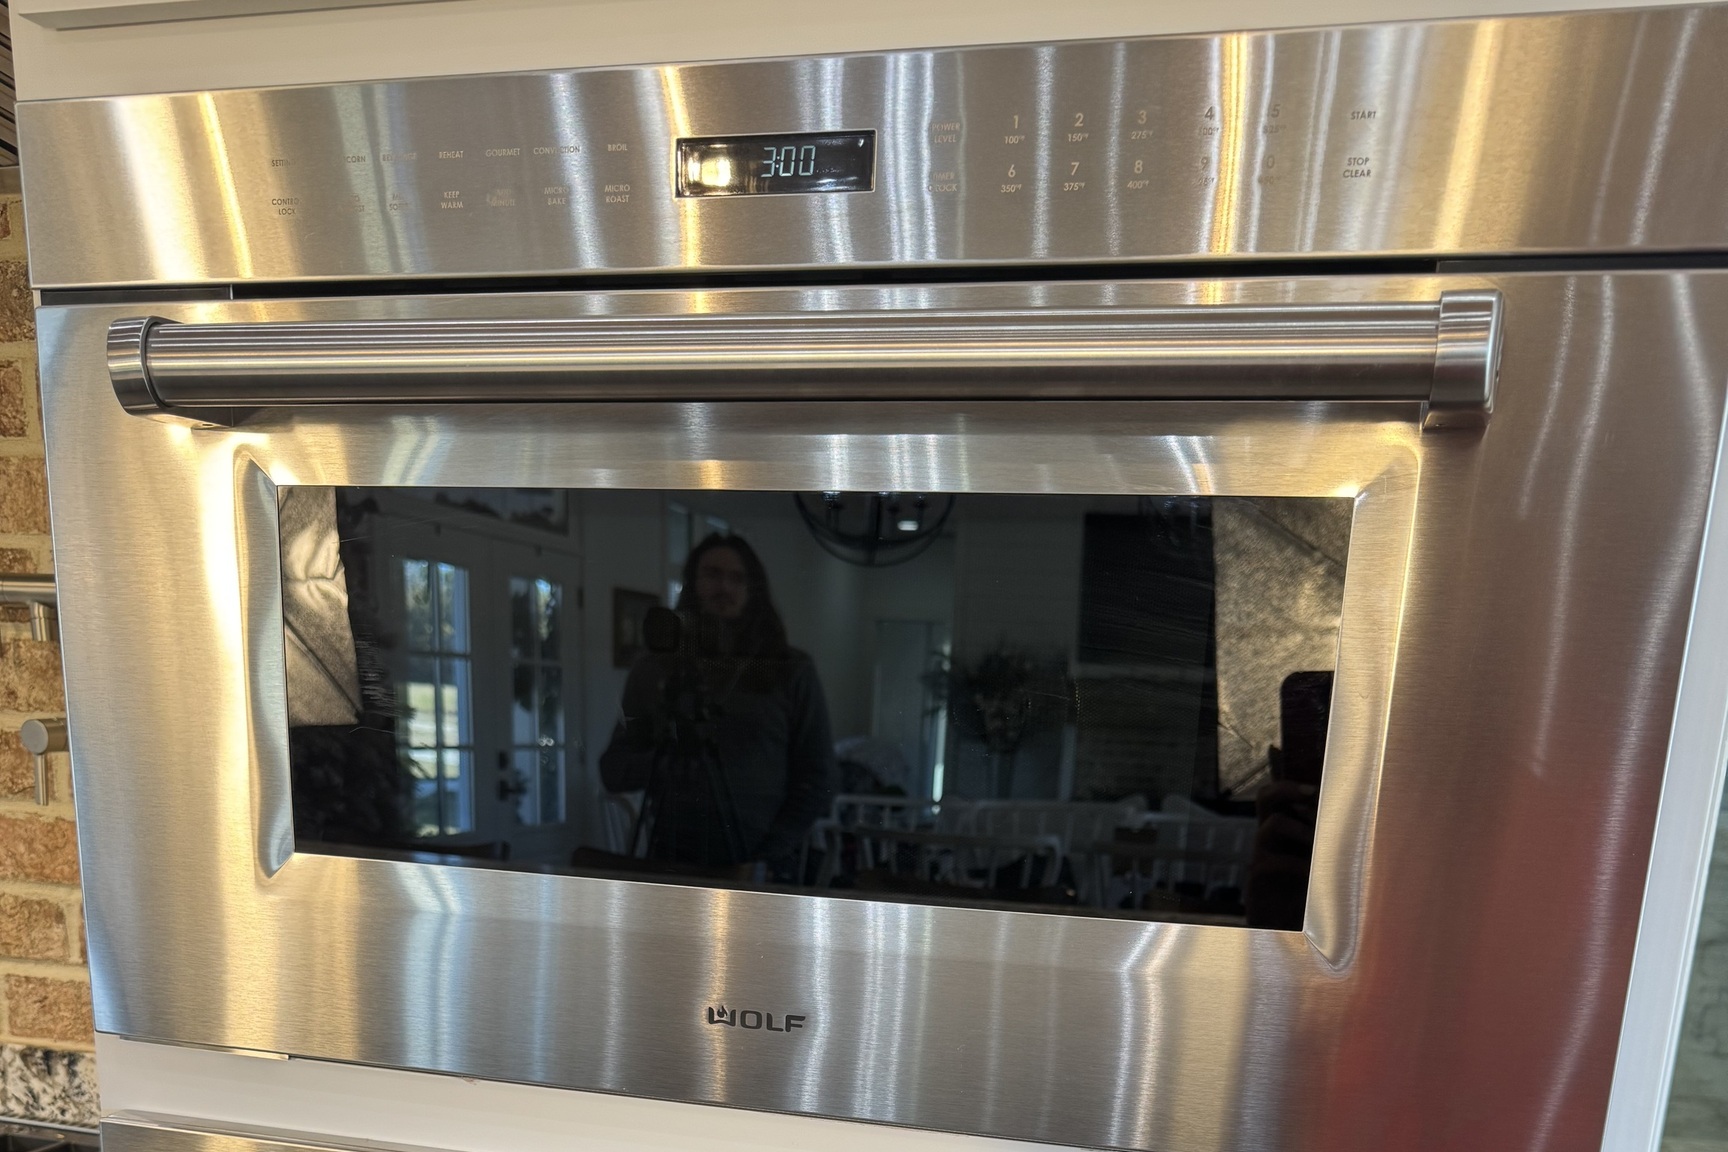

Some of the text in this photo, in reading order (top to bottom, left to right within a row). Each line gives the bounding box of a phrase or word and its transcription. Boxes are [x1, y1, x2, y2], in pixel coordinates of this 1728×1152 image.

[1205, 106, 1214, 120] 4
[1271, 104, 1281, 118] 5
[1350, 111, 1377, 119] START
[1013, 115, 1019, 128] 1
[1074, 113, 1084, 127] 2
[1138, 110, 1147, 125] 3
[932, 122, 960, 131] POWER
[934, 134, 956, 143] LEVEL
[486, 148, 520, 157] GOURMET
[607, 144, 628, 152] BROIL
[439, 151, 464, 159] REHEAT
[761, 145, 816, 178] 3:00
[1201, 157, 1210, 170] 9
[1347, 157, 1370, 166] STOP
[1008, 164, 1016, 178] 6
[1071, 162, 1080, 176] 7
[1134, 160, 1143, 174] 8
[1342, 169, 1371, 178] CLEAR
[544, 186, 569, 195] MICRO
[604, 184, 630, 193] MICRO
[444, 191, 460, 199] KEEP
[606, 195, 630, 203] ROAST
[441, 201, 464, 209] WARM
[708, 1005, 806, 1032] WOLF
